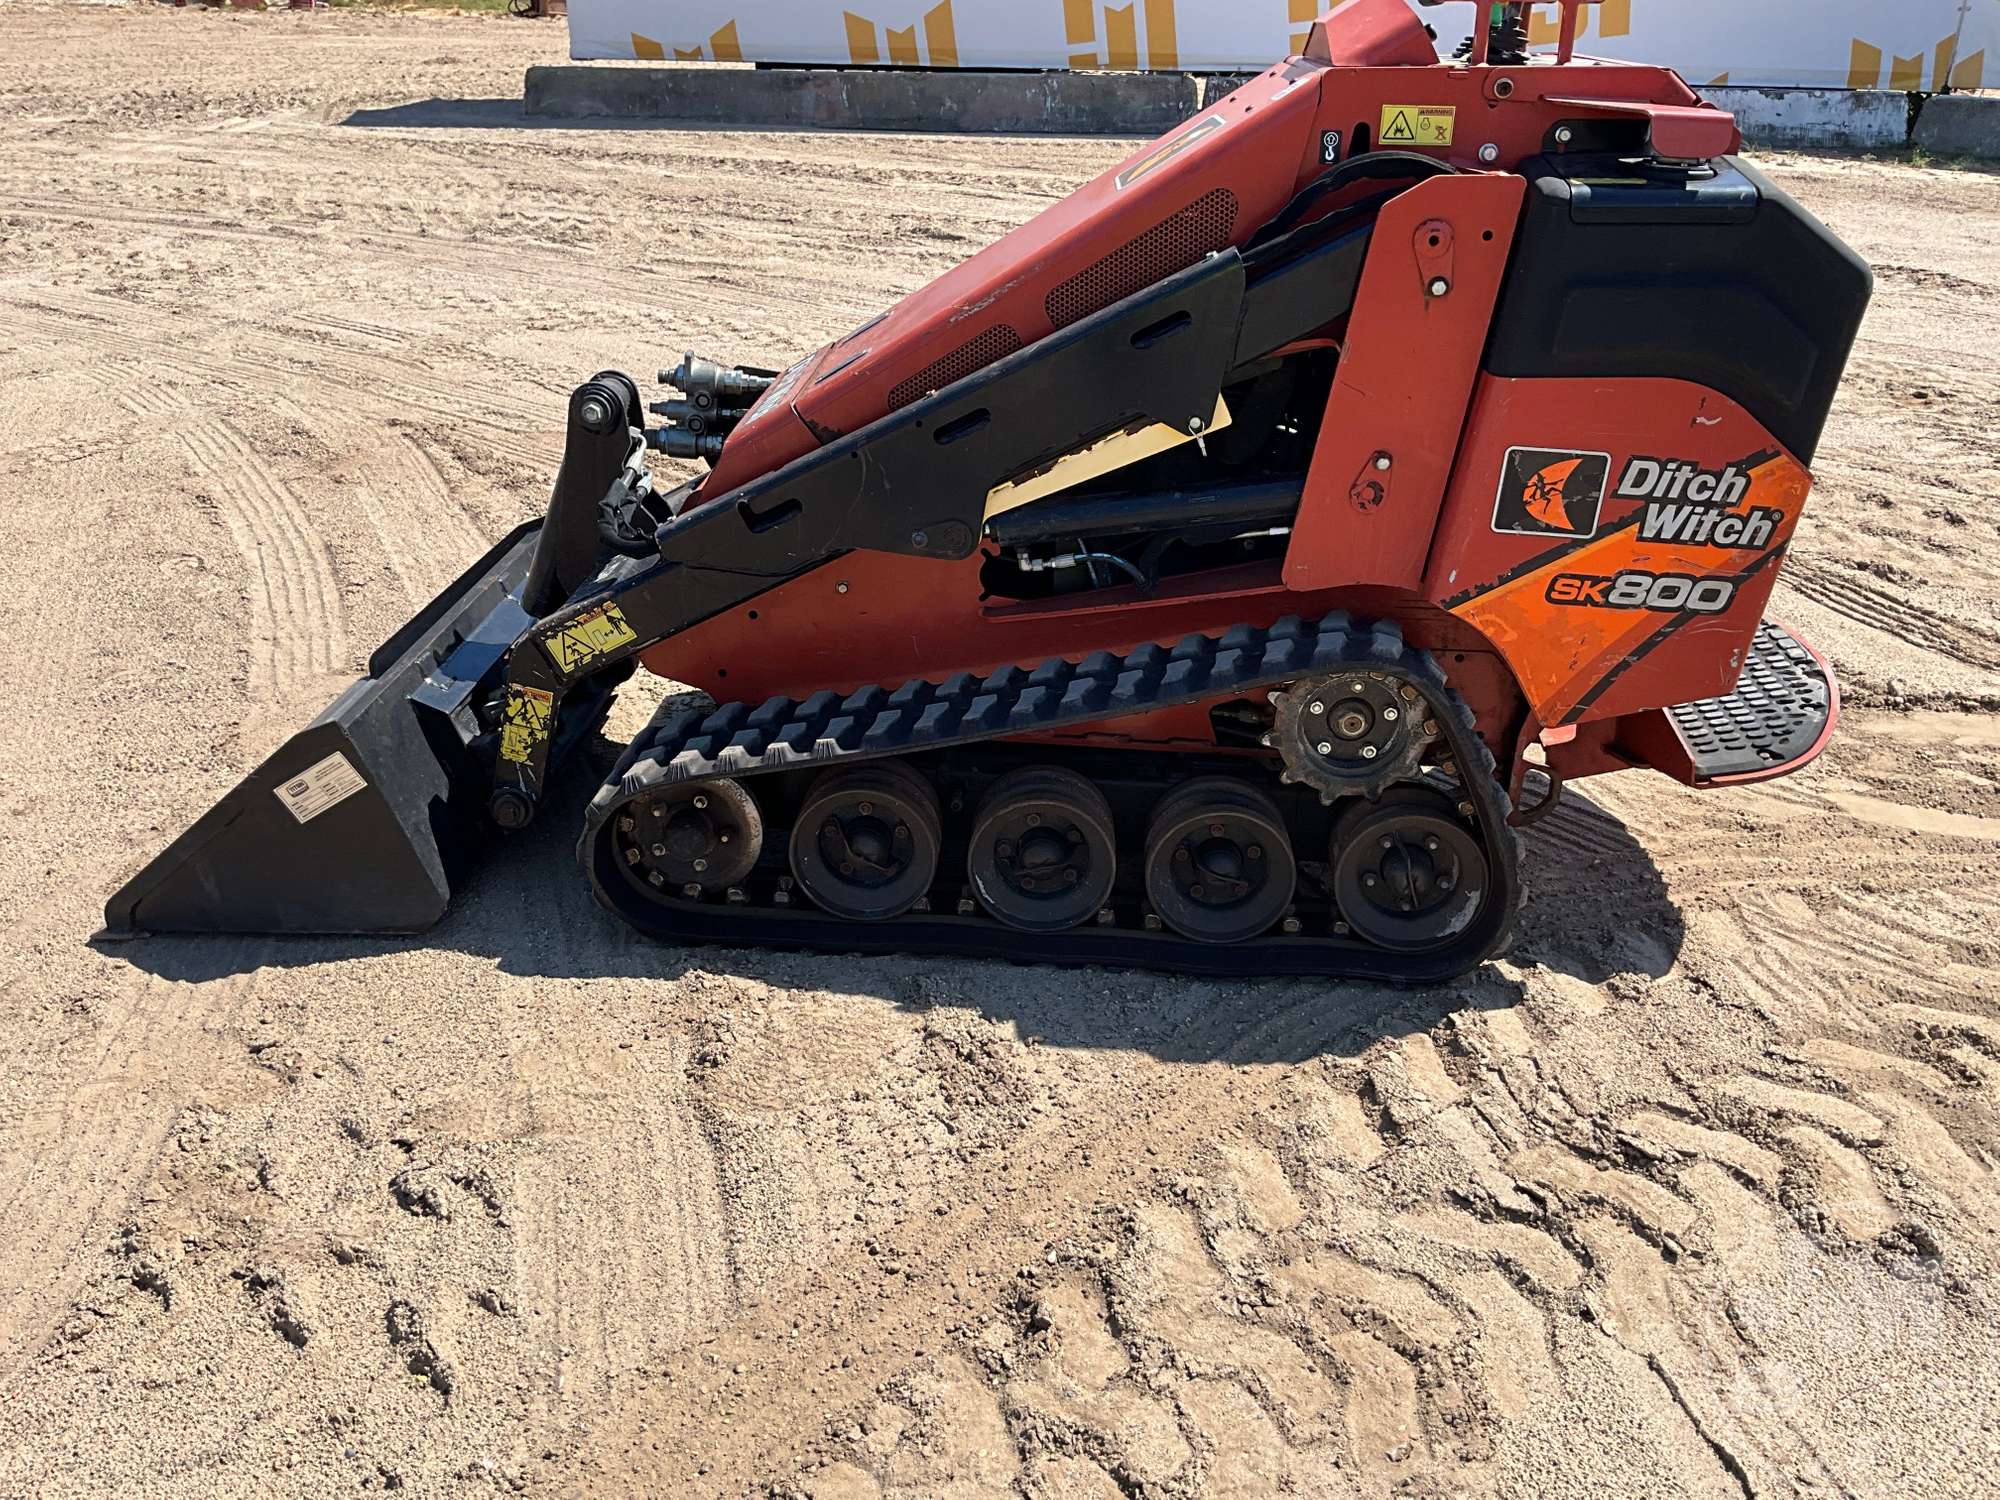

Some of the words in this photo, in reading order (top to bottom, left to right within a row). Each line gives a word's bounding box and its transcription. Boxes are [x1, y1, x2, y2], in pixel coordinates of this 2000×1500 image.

[1617, 460, 1747, 503] Ditch
[1641, 504, 1773, 546] Witch
[1550, 575, 1734, 611] SK800
